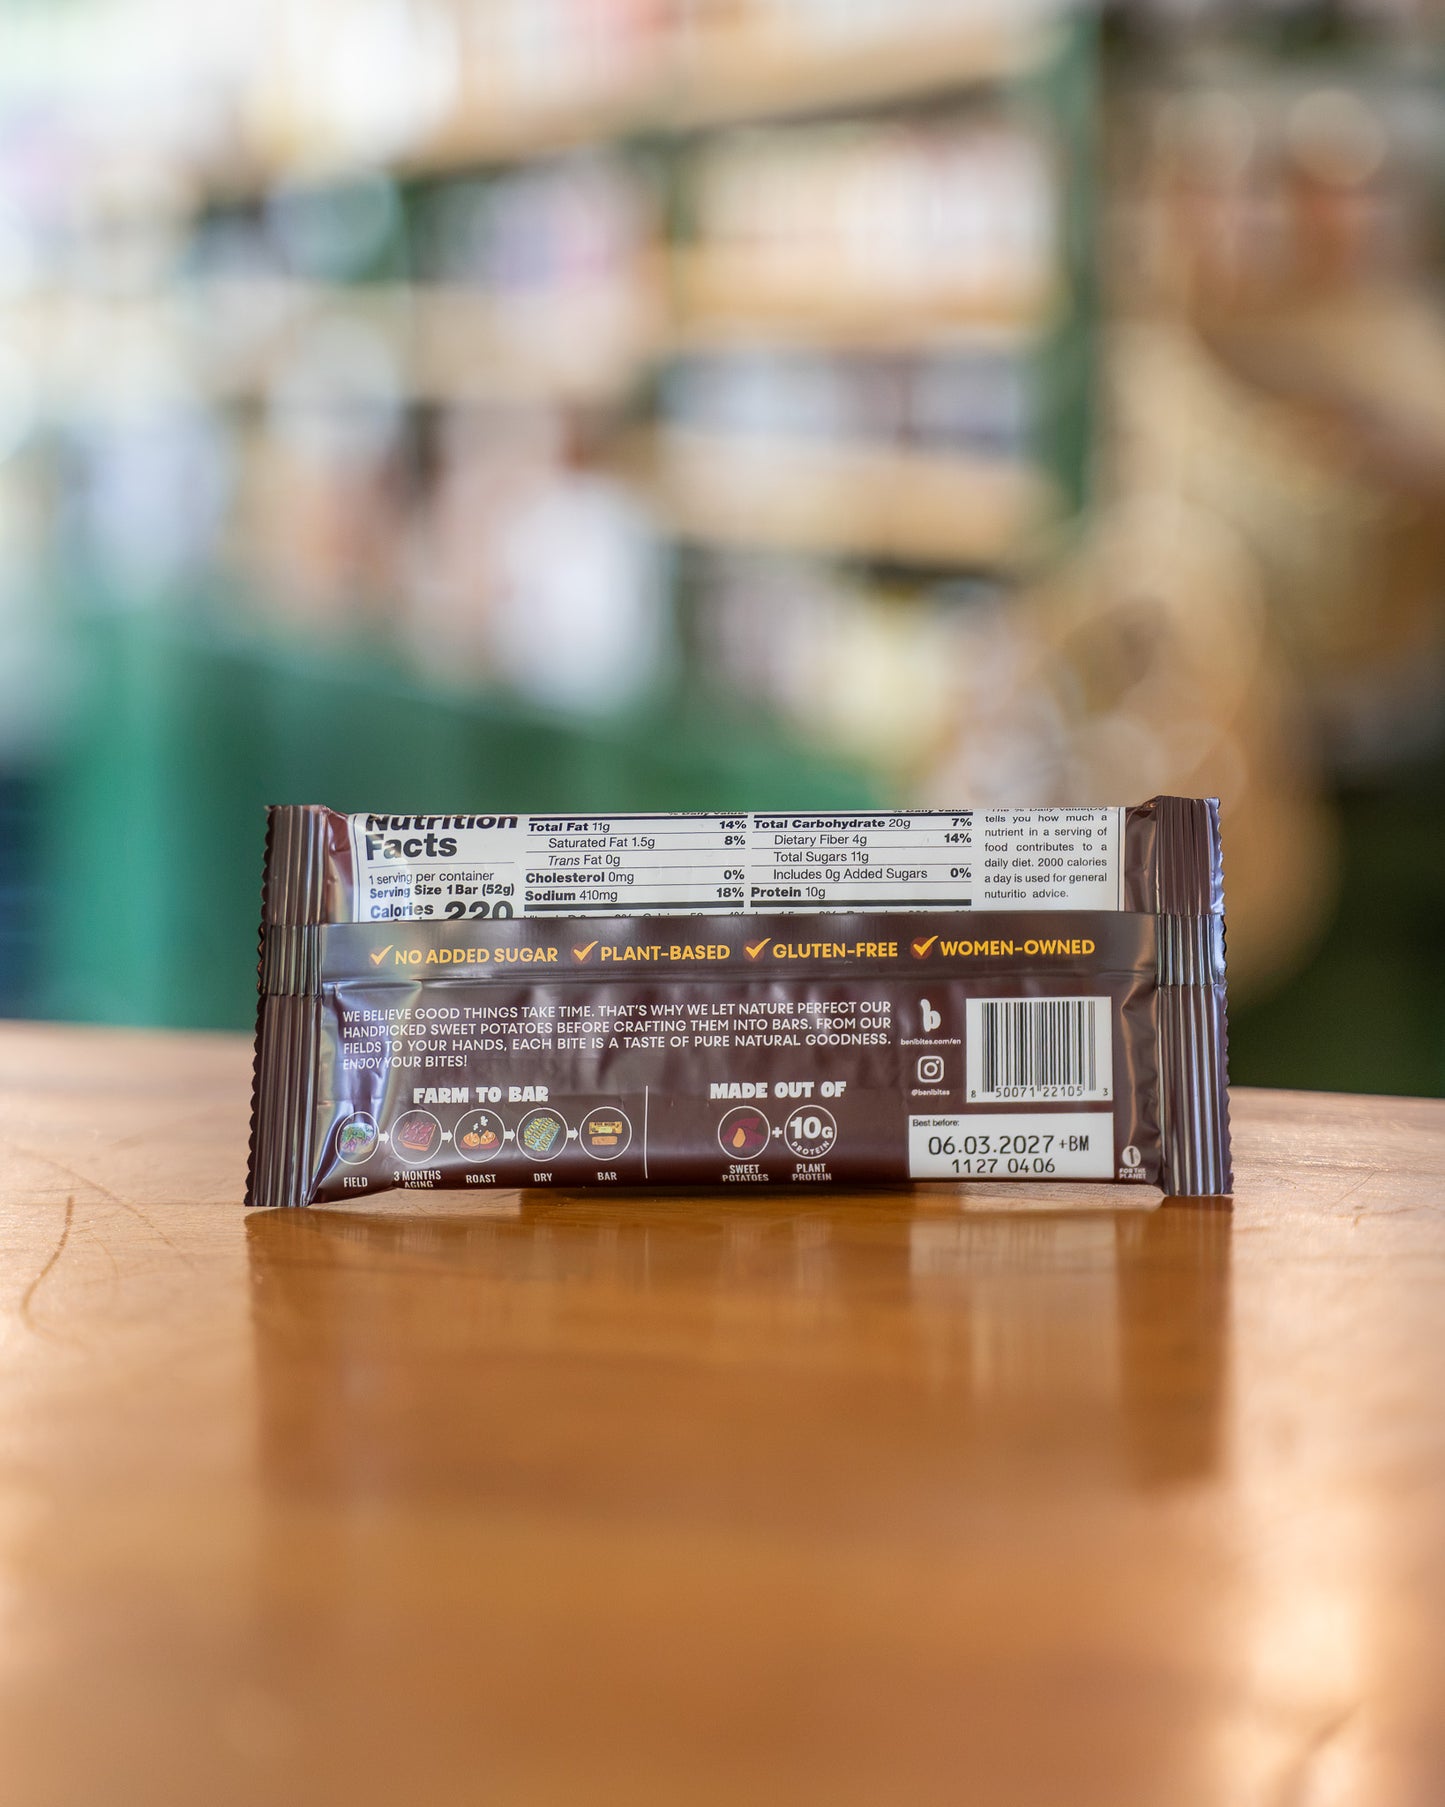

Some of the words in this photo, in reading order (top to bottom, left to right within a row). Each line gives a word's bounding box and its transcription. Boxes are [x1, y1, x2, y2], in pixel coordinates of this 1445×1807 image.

[366, 815, 518, 831] Nutrition
[754, 820, 788, 828] Total
[792, 819, 886, 829] Carbohydrate
[888, 819, 911, 828] 20g
[951, 818, 972, 827] 7%
[1013, 816, 1031, 824] you
[1038, 814, 1059, 822] how
[529, 823, 564, 832] Total
[567, 822, 588, 831] Fat
[592, 822, 610, 832] 11g
[719, 820, 747, 829] 14%
[985, 828, 1024, 836] nutrient
[1029, 828, 1038, 836] in
[1055, 828, 1092, 837] serving
[1098, 827, 1107, 835] of
[549, 837, 606, 849] Saturated
[609, 837, 628, 847] Fat
[631, 837, 655, 849] 1.5g
[725, 836, 745, 845] 8%
[774, 835, 817, 845] Dietary
[820, 835, 849, 844] Fiber
[852, 835, 867, 845] 4g
[944, 834, 972, 843] 14%
[366, 833, 457, 861] Facts
[985, 843, 1008, 852] food
[1016, 843, 1074, 851] contributes
[1083, 843, 1092, 851] to
[548, 856, 580, 866] Trans
[583, 855, 602, 865] Fat
[605, 855, 621, 867] 0g
[774, 852, 803, 862] Total
[805, 852, 847, 863] Sugars
[851, 852, 869, 863] 11g
[985, 858, 1008, 869] daily
[1012, 858, 1033, 867] diet.
[1038, 858, 1063, 867] 2000
[1067, 857, 1107, 866] calories
[369, 876, 374, 885] 1
[377, 874, 412, 884] serving
[416, 872, 435, 883] per
[439, 871, 494, 881] container
[525, 872, 605, 883] Cholesterol
[608, 872, 635, 884] 0mg
[724, 870, 745, 880] 0%
[773, 870, 823, 880] Includes
[825, 869, 841, 881] 0g
[843, 869, 883, 879] Added
[886, 869, 928, 880] Sugars
[950, 868, 972, 878] 0%
[993, 874, 1011, 884] day
[1014, 874, 1022, 882] is
[1025, 873, 1050, 882] used
[1053, 873, 1066, 882] for
[1069, 873, 1107, 884] general
[370, 888, 410, 899] Serving
[414, 885, 442, 895] Size
[447, 885, 452, 895] 1
[456, 884, 478, 895] Bar
[482, 884, 514, 896] (52g)
[525, 890, 576, 901] Sodium
[579, 890, 618, 902] 410mg
[716, 888, 744, 898] 18%
[751, 887, 801, 897] Protein
[805, 887, 826, 898] 10g
[985, 889, 1027, 898] nuturitio
[1032, 889, 1068, 898] advice.
[371, 903, 434, 919] Calories
[445, 901, 513, 919] 220
[601, 945, 731, 961] PLANT-BASED
[772, 942, 898, 958] GLUTEN-FREE
[940, 940, 1095, 956] WOMEN-OWNED
[395, 950, 422, 965] NO
[425, 948, 489, 964] ADDED
[494, 948, 558, 962] SUGAR
[343, 1011, 360, 1022] WE
[363, 1009, 411, 1021] BELIEVE
[415, 1008, 460, 1019] GOOD
[464, 1007, 518, 1019] THINGS
[521, 1007, 555, 1018] TAKE
[558, 1006, 595, 1017] TIME.
[650, 1005, 683, 1016] WHY
[687, 1004, 708, 1015] WE
[712, 1004, 735, 1015] LET
[739, 1003, 794, 1014] NATURE
[797, 1002, 857, 1013] PERFECT
[860, 1002, 891, 1013] OUR
[343, 1024, 427, 1038] HANDPICKED
[430, 1024, 476, 1036] SWEET
[480, 1023, 552, 1034] POTATOES
[557, 1022, 609, 1033] BEFORE
[613, 1020, 686, 1033] CRAFTING
[691, 1020, 729, 1031] THEM
[733, 1019, 768, 1030] INTO
[772, 1019, 812, 1030] BARS.
[816, 1018, 856, 1029] FROM
[860, 1017, 891, 1029] OUR
[344, 1042, 382, 1054] FIELDS
[385, 1041, 402, 1052] TO
[407, 1040, 447, 1051] YOUR
[452, 1039, 507, 1052] HANDS,
[512, 1038, 551, 1050] EACH
[557, 1038, 586, 1049] BITE
[591, 1038, 604, 1049] IS
[609, 1038, 619, 1048] A
[624, 1037, 665, 1048] TASTE
[670, 1036, 689, 1047] OF
[695, 1035, 730, 1047] PURE
[735, 1035, 800, 1046] NATURAL
[805, 1034, 891, 1046] GOODNESS.
[343, 1058, 381, 1070] ENJOY
[384, 1057, 422, 1068] YOUR
[425, 1055, 467, 1067] BITES!
[413, 1088, 469, 1103] FARM
[476, 1087, 502, 1102] TO
[509, 1086, 549, 1102] BAR
[710, 1083, 768, 1099] MADE
[774, 1082, 814, 1098] OUT
[820, 1081, 847, 1097] OF
[971, 1090, 976, 1098] 8
[996, 1086, 1036, 1098] 50071
[1043, 1086, 1083, 1097] 22105
[790, 1116, 833, 1139] 10G
[912, 1119, 930, 1127] Best
[932, 1119, 959, 1127] before:
[791, 1140, 830, 1155] PROTEIN
[928, 1135, 1054, 1155] 06.03.2027
[729, 1165, 759, 1174] SWEET
[796, 1163, 826, 1173] PLANT
[952, 1159, 998, 1174] 1127
[1007, 1158, 1055, 1173] 0406
[343, 1176, 368, 1187] FIELD
[394, 1171, 400, 1181] 3
[402, 1170, 442, 1181] MONTHS
[466, 1174, 496, 1183] ROAST
[534, 1172, 552, 1182] DRY
[598, 1172, 617, 1181] BAR
[722, 1174, 769, 1182] POTATOES
[792, 1173, 832, 1181] PROTEIN
[404, 1180, 434, 1188] AGING
